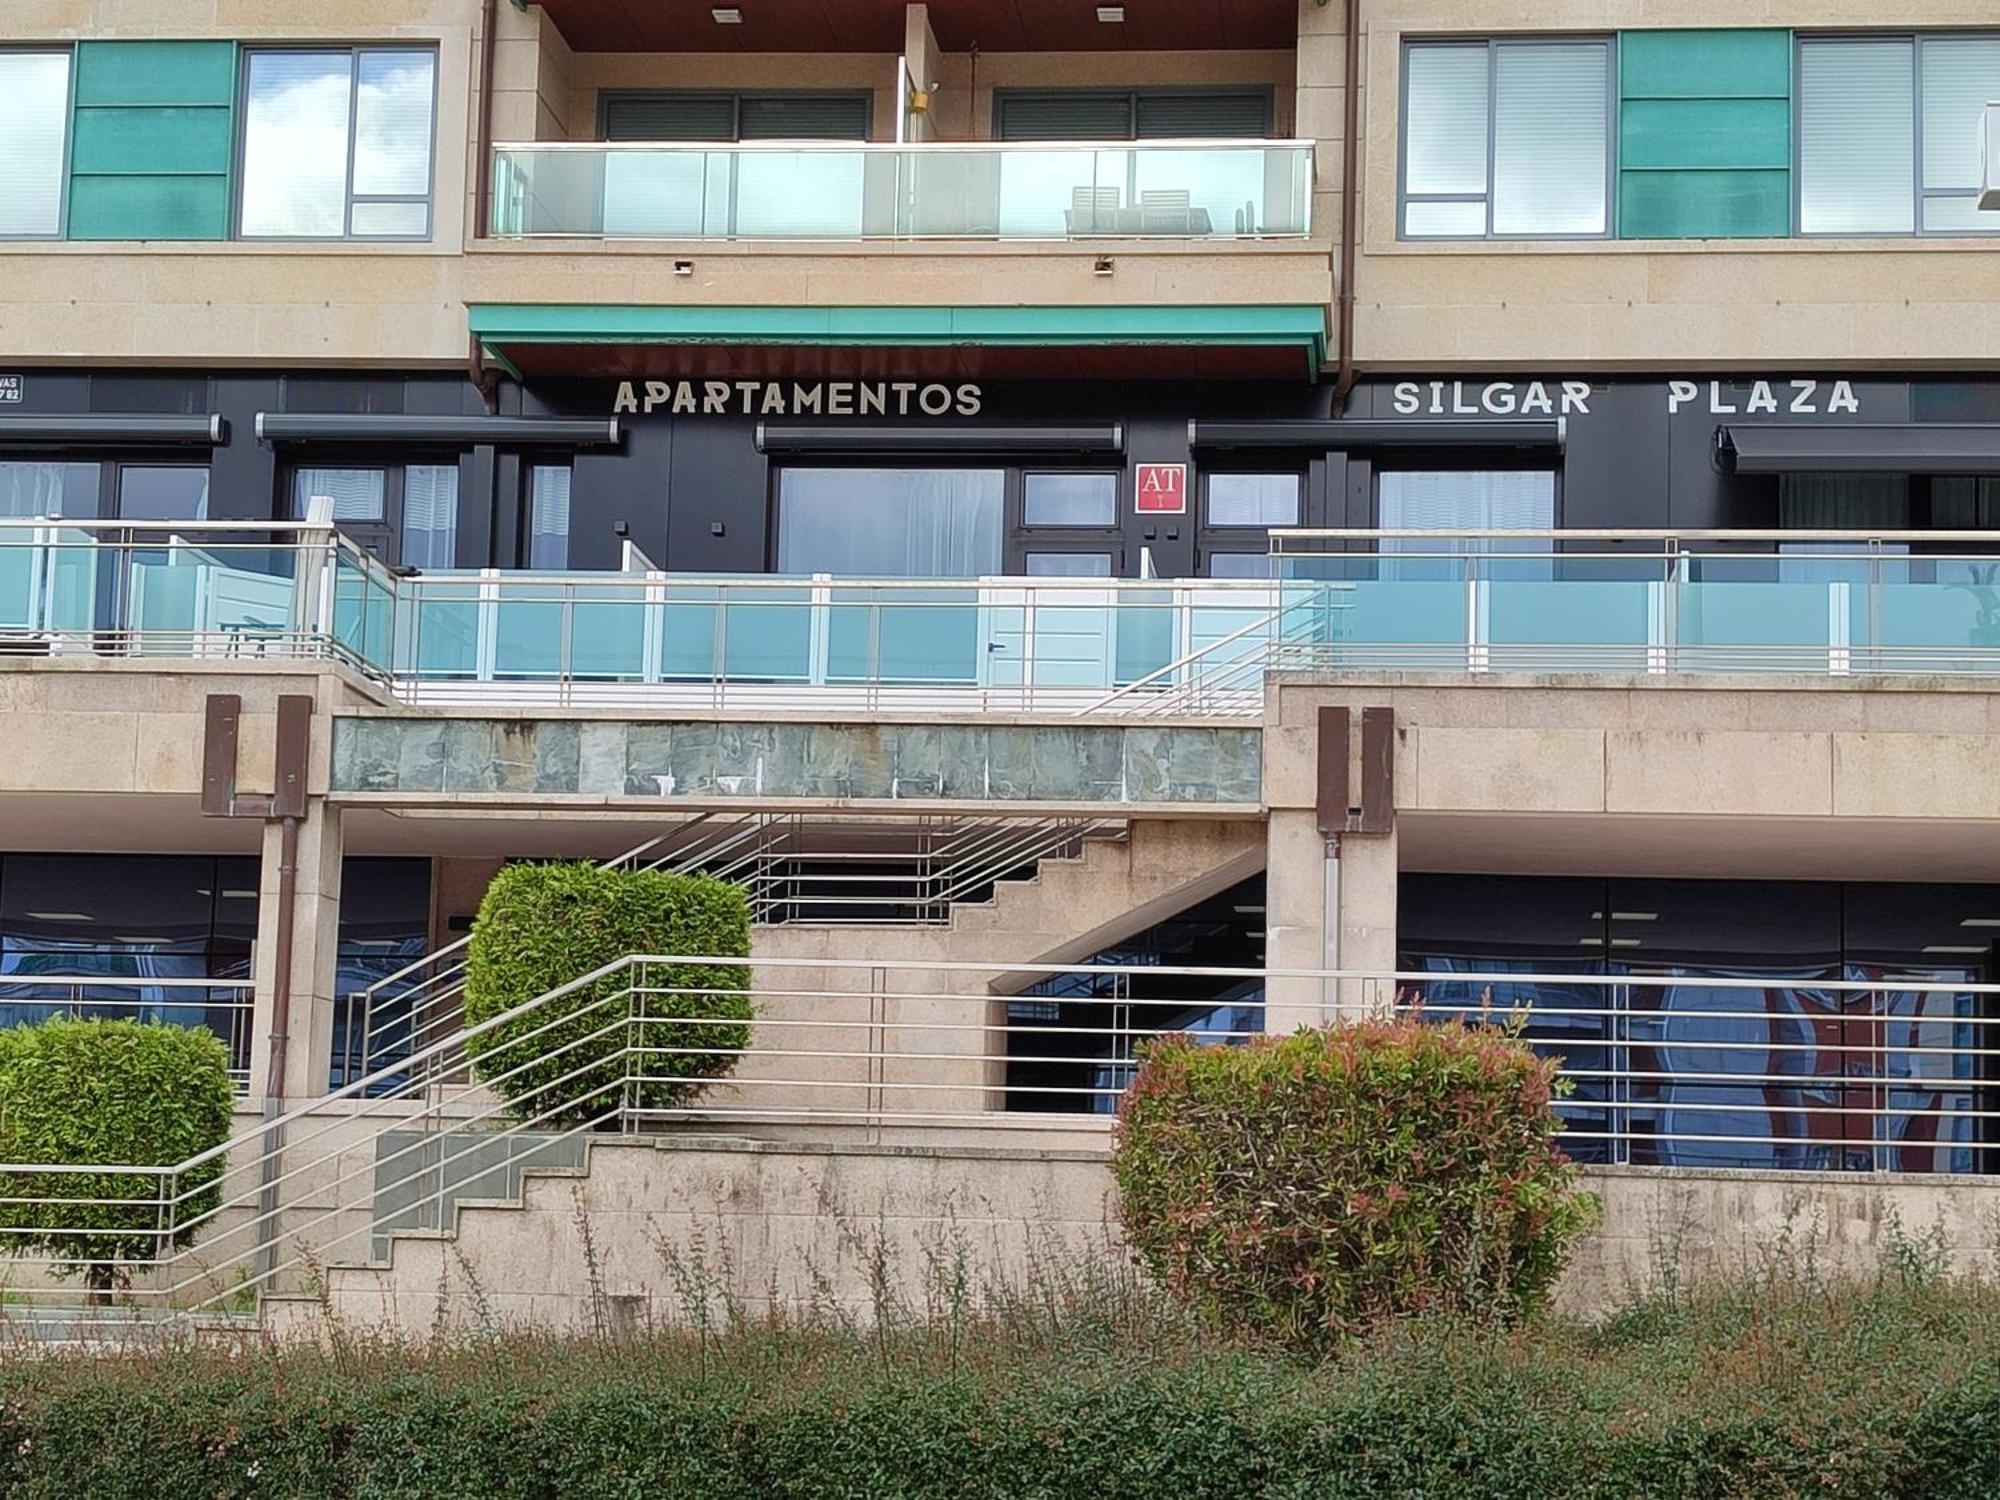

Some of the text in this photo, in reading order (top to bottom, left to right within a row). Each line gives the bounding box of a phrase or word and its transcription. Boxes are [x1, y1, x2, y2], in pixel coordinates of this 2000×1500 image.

[613, 380, 1859, 416] APARTAMENTOS SILGAR PLAZA
[1141, 468, 1181, 492] AT
